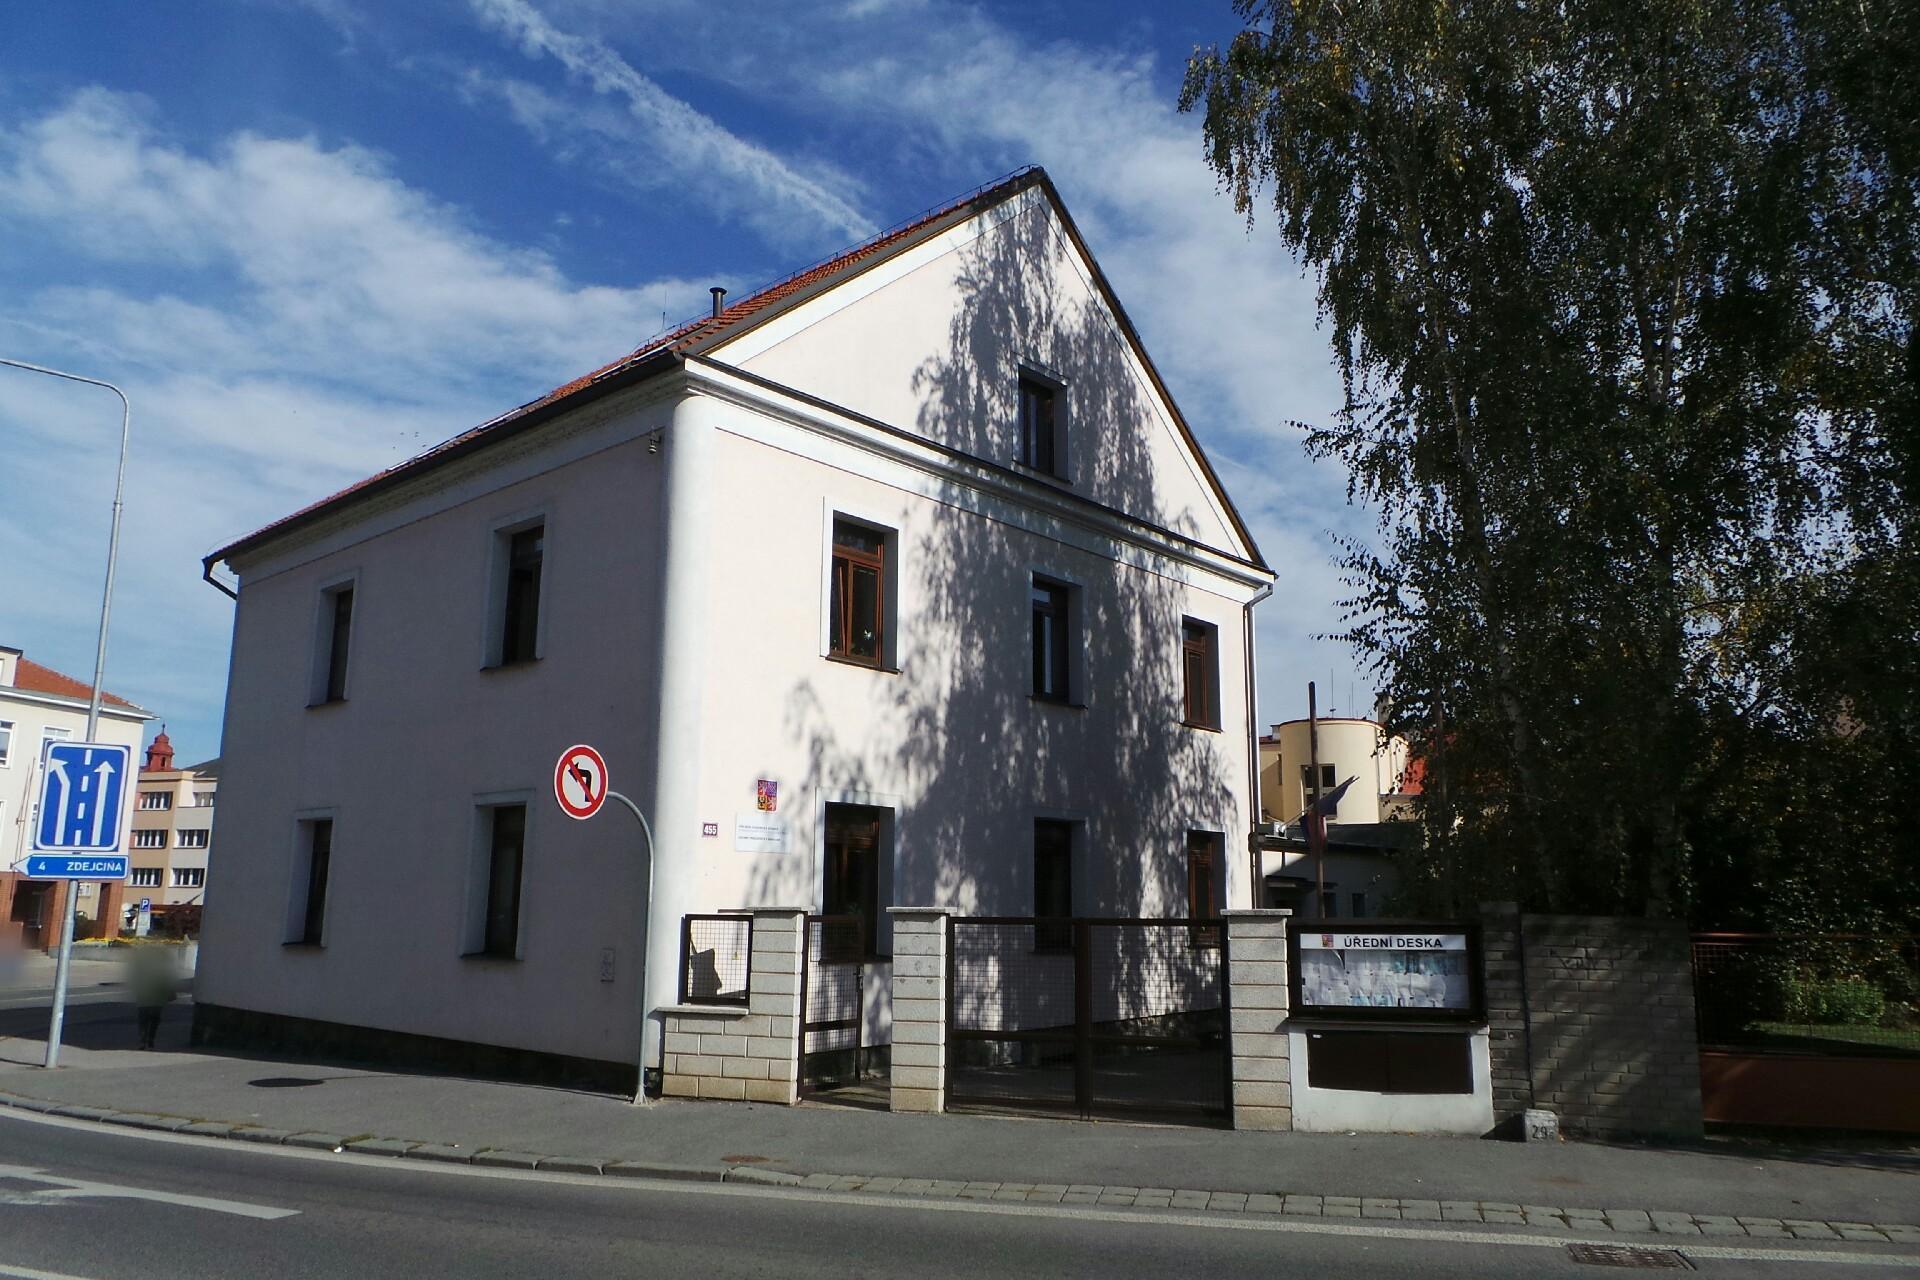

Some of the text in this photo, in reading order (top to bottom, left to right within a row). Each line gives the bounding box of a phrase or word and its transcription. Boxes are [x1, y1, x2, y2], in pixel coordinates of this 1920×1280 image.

[703, 825, 717, 835] 455
[38, 861, 46, 871] 4
[142, 899, 149, 909] P
[1344, 935, 1443, 948] ÚŘEDNÍ DESKA
